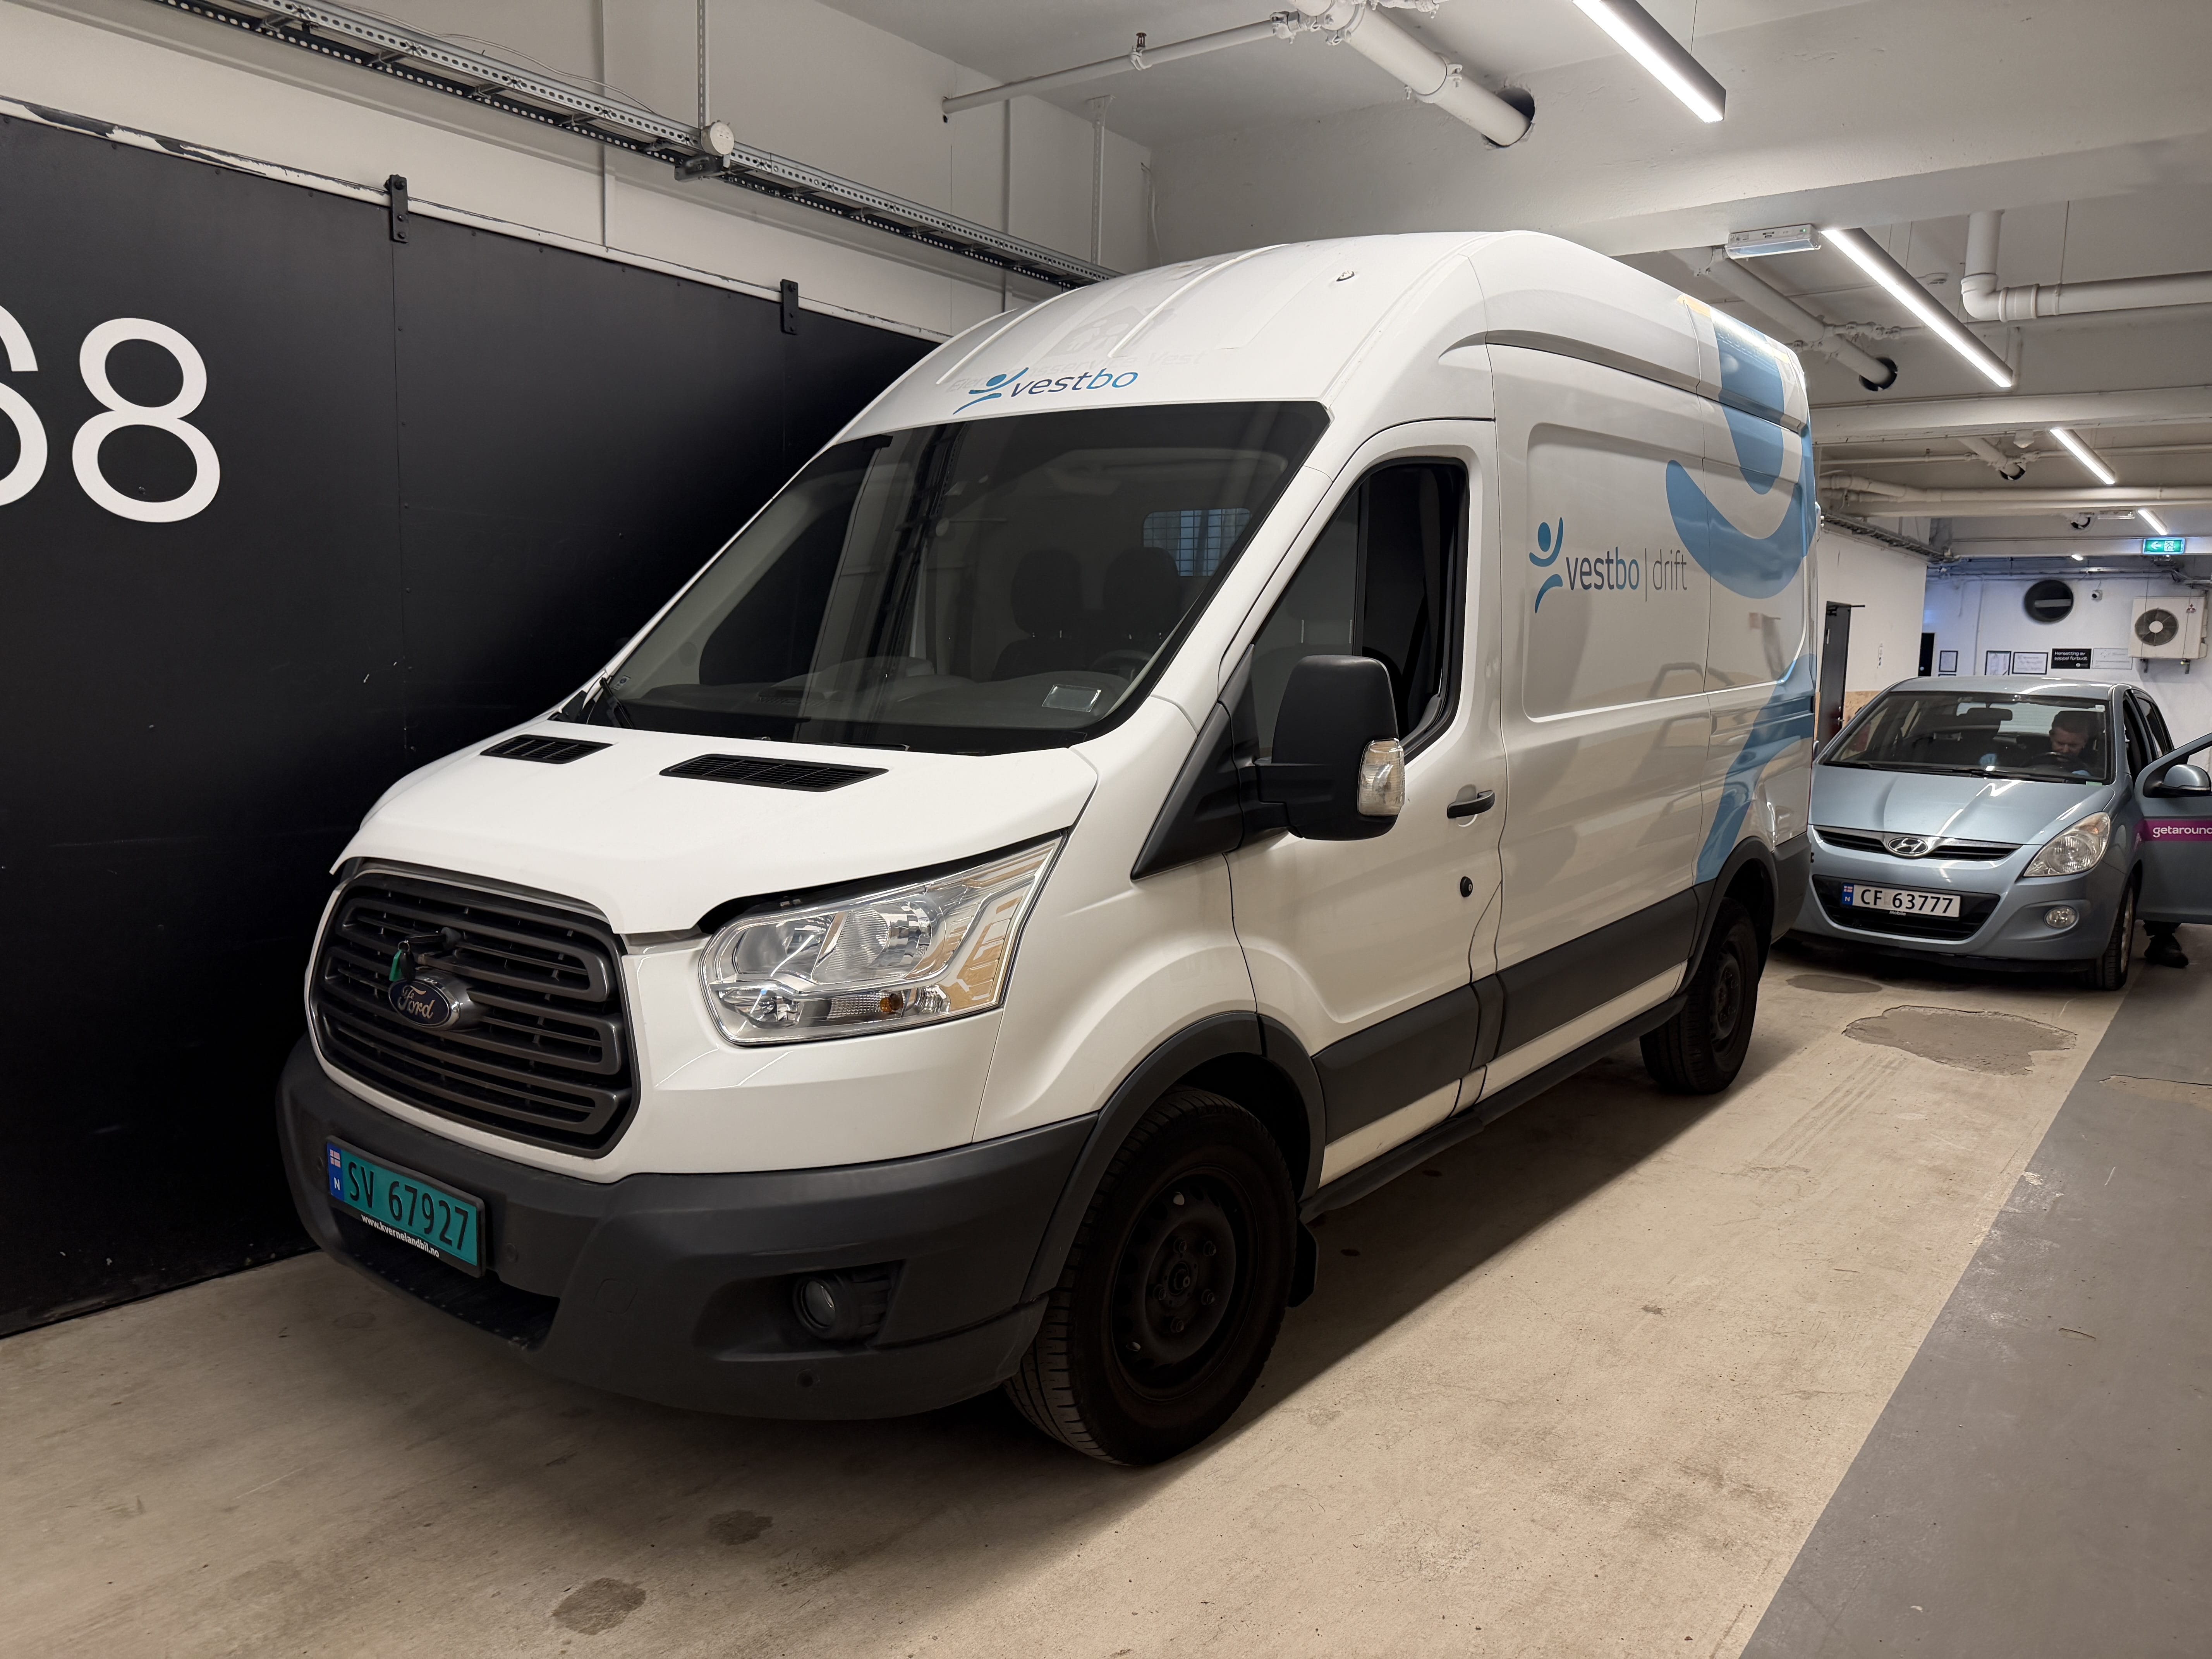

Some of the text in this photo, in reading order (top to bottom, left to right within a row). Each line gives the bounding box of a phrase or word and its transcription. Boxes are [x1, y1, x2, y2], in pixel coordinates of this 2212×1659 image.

[1010, 368, 1138, 397] vestbo
[1566, 546, 1687, 591] vestbo drift
[1860, 889, 1953, 914] CF 63777
[397, 985, 435, 1019] Ford
[333, 1177, 341, 1191] N
[348, 1161, 469, 1251] SV 67927
[361, 1214, 440, 1258] www.kvernelandbil.no
